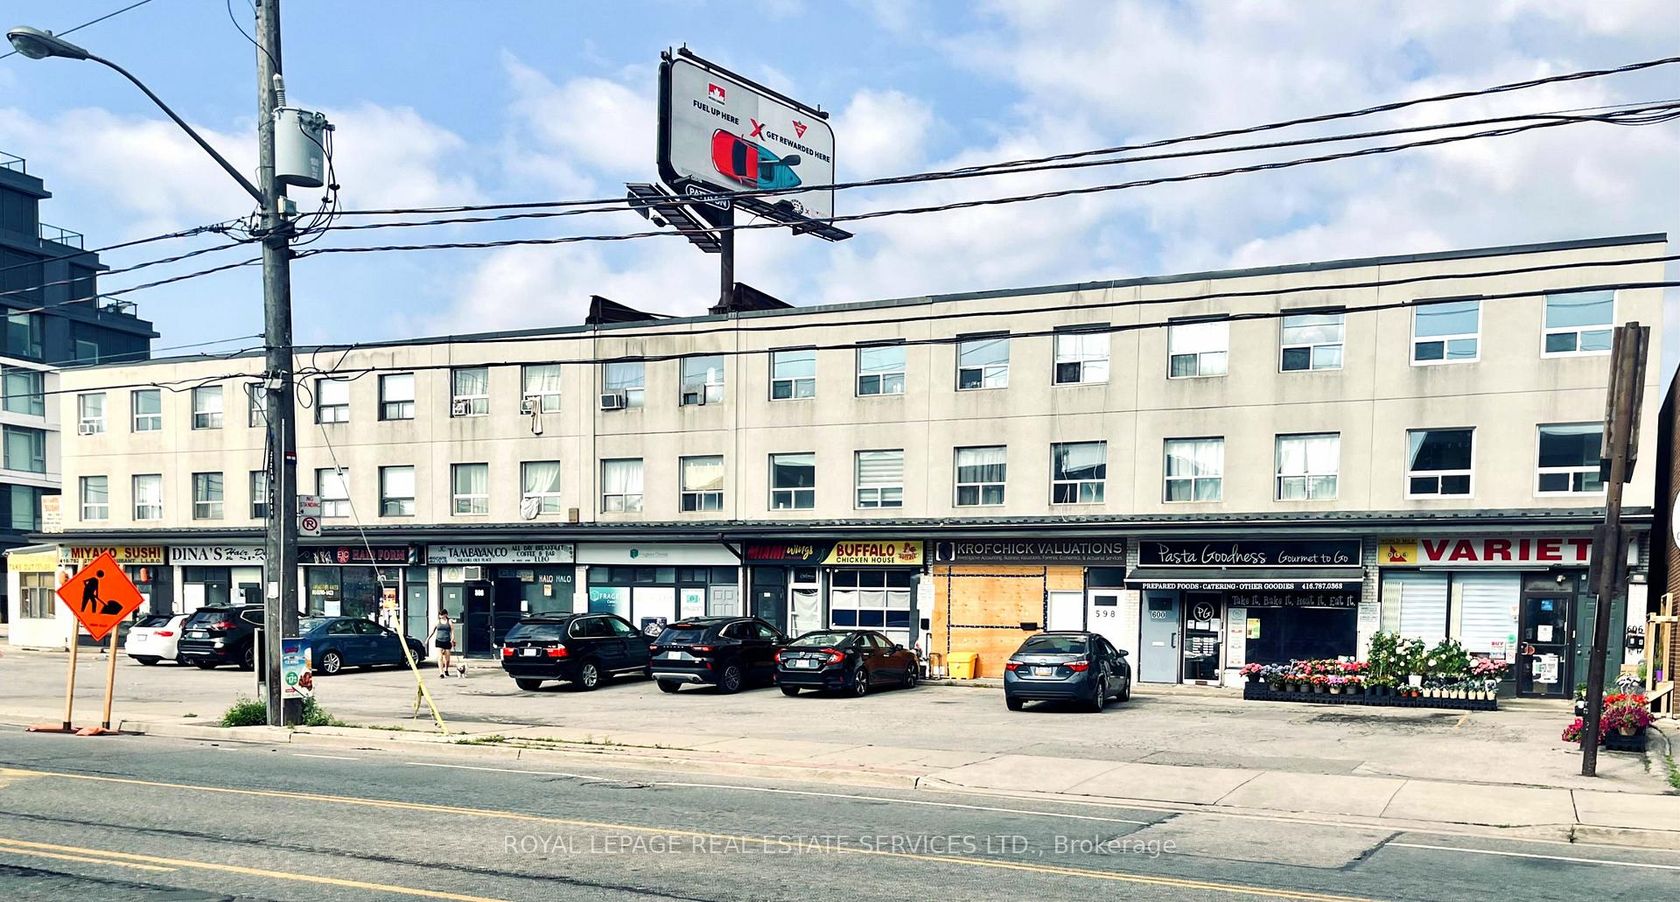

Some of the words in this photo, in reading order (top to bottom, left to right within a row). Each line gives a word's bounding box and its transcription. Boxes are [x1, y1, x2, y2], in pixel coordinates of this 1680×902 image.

[693, 99, 710, 113] FUEL
[710, 108, 721, 118] UP
[721, 112, 740, 126] HERE
[766, 130, 780, 142] GET
[779, 135, 815, 156] REWARDED
[814, 150, 831, 163] HERE
[125, 546, 161, 558] SUSHI
[172, 547, 223, 561] DINA'S
[837, 543, 896, 557] BUFFALO
[957, 543, 1034, 554] KROFCHICK
[1037, 542, 1123, 553] VALUATIONS
[1157, 543, 1197, 563] Pasta
[1201, 544, 1266, 564] Goodness
[1278, 550, 1318, 563] Gourmet
[1320, 552, 1331, 562] to
[1333, 550, 1349, 563] Go
[1421, 538, 1594, 561] VARIET
[538, 575, 554, 583] HALO
[555, 575, 572, 583] HALO
[1152, 610, 1167, 619] 600
[1197, 606, 1211, 619] PG
[1627, 625, 1644, 634] 606
